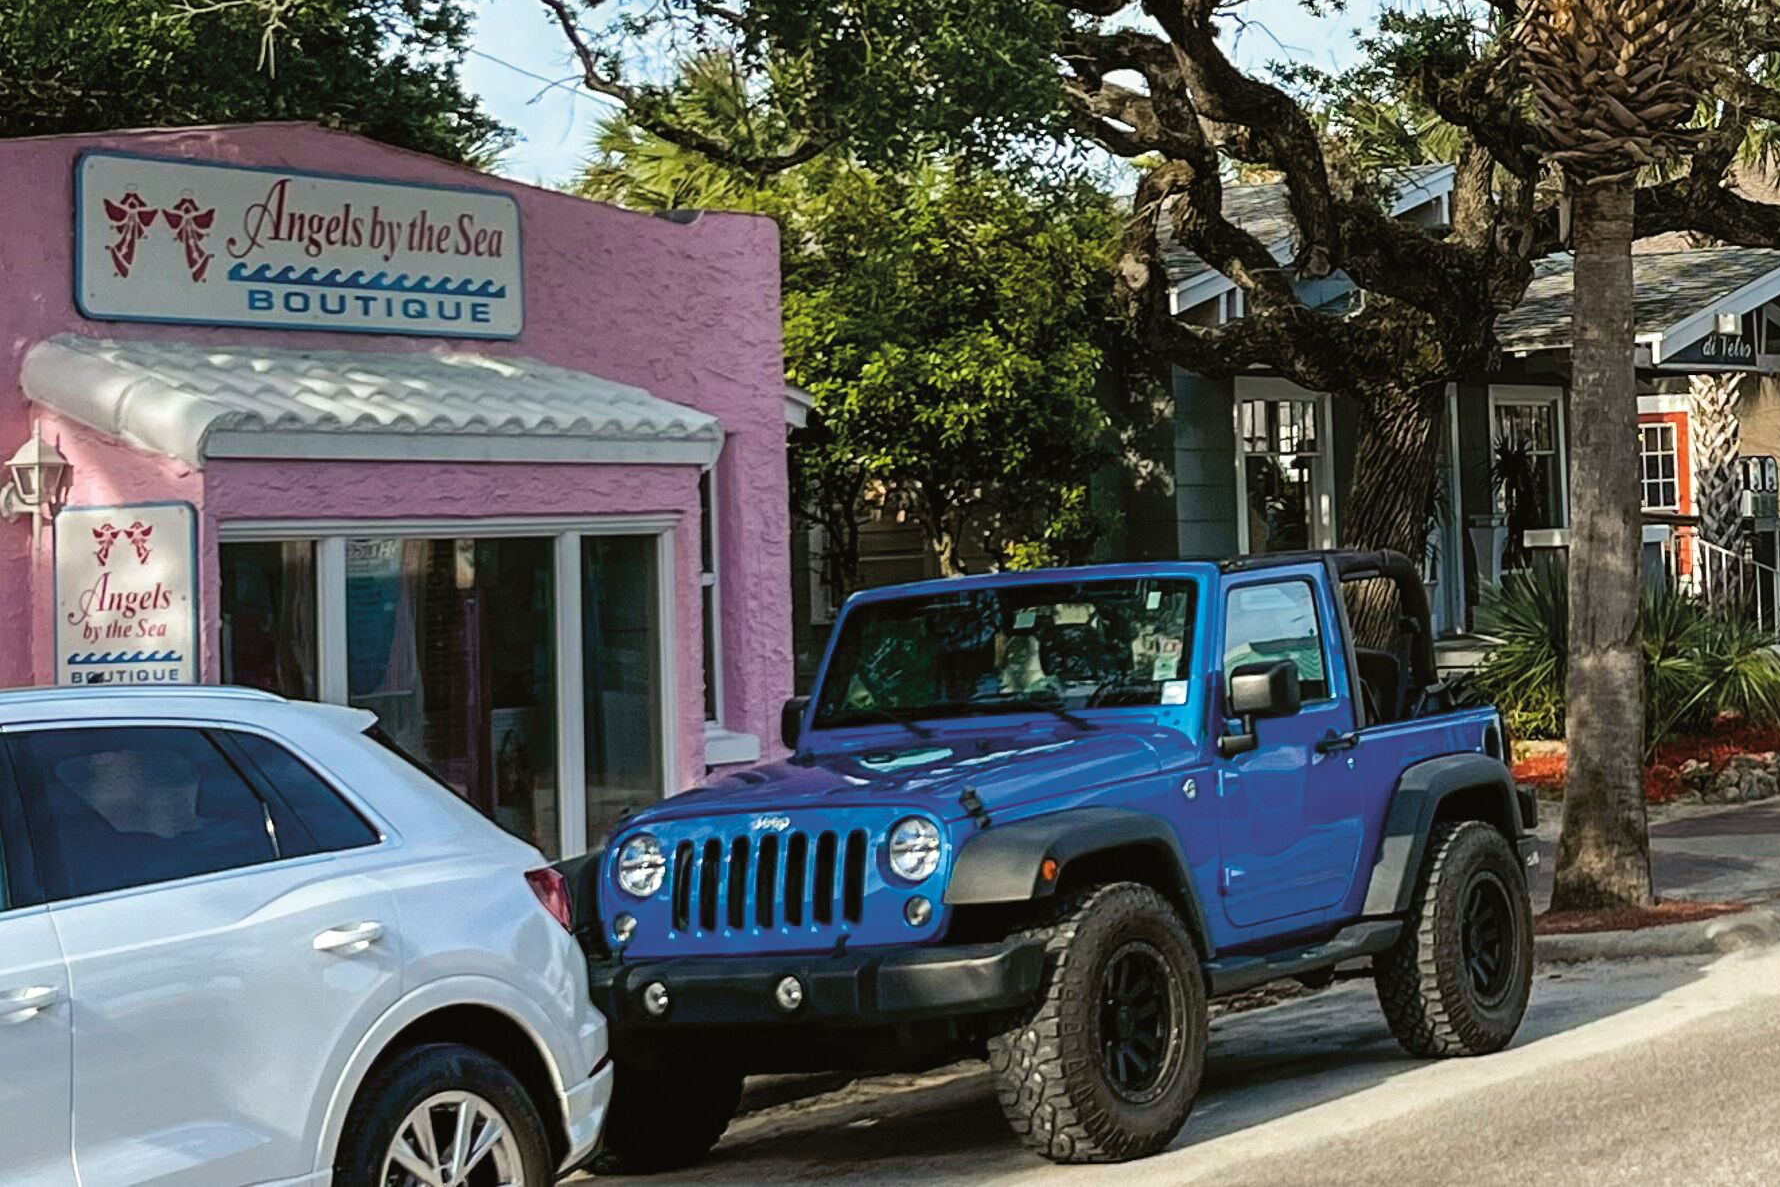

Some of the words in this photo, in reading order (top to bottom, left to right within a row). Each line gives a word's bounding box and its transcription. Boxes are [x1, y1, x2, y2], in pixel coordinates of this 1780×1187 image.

[226, 178, 364, 258] Angels
[369, 205, 402, 261] by
[407, 210, 451, 254] the
[454, 213, 504, 259] Sea
[248, 289, 492, 323] BOUTIQUE
[67, 571, 172, 626] Angels
[82, 621, 101, 645] by
[105, 620, 133, 639] the
[135, 618, 167, 638] Sea
